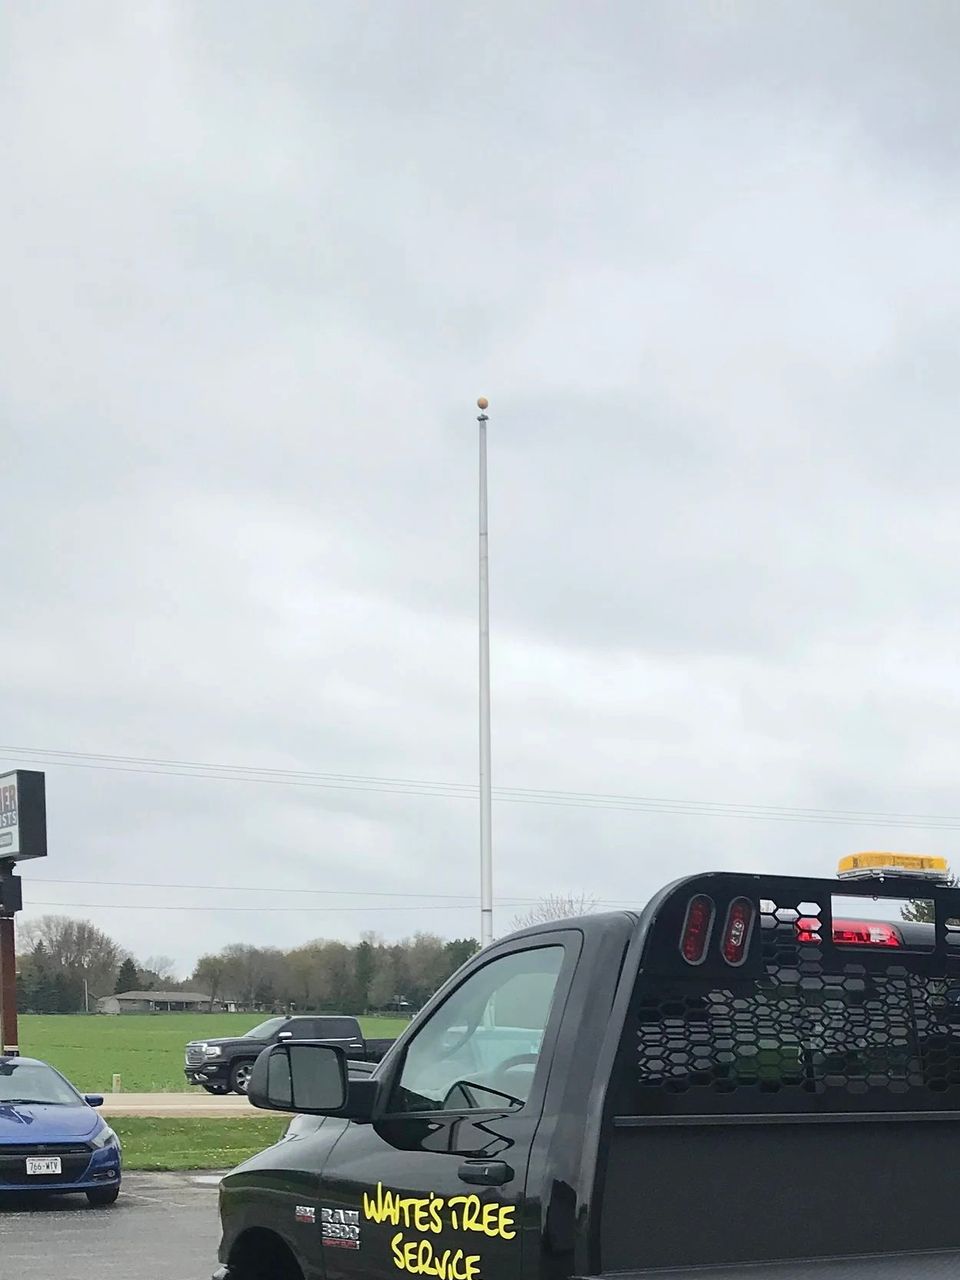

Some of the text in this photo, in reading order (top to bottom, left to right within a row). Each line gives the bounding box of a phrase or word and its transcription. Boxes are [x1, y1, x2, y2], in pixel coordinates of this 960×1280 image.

[321, 1207, 360, 1225] RAM
[363, 1181, 517, 1240] WAITE'S TREE
